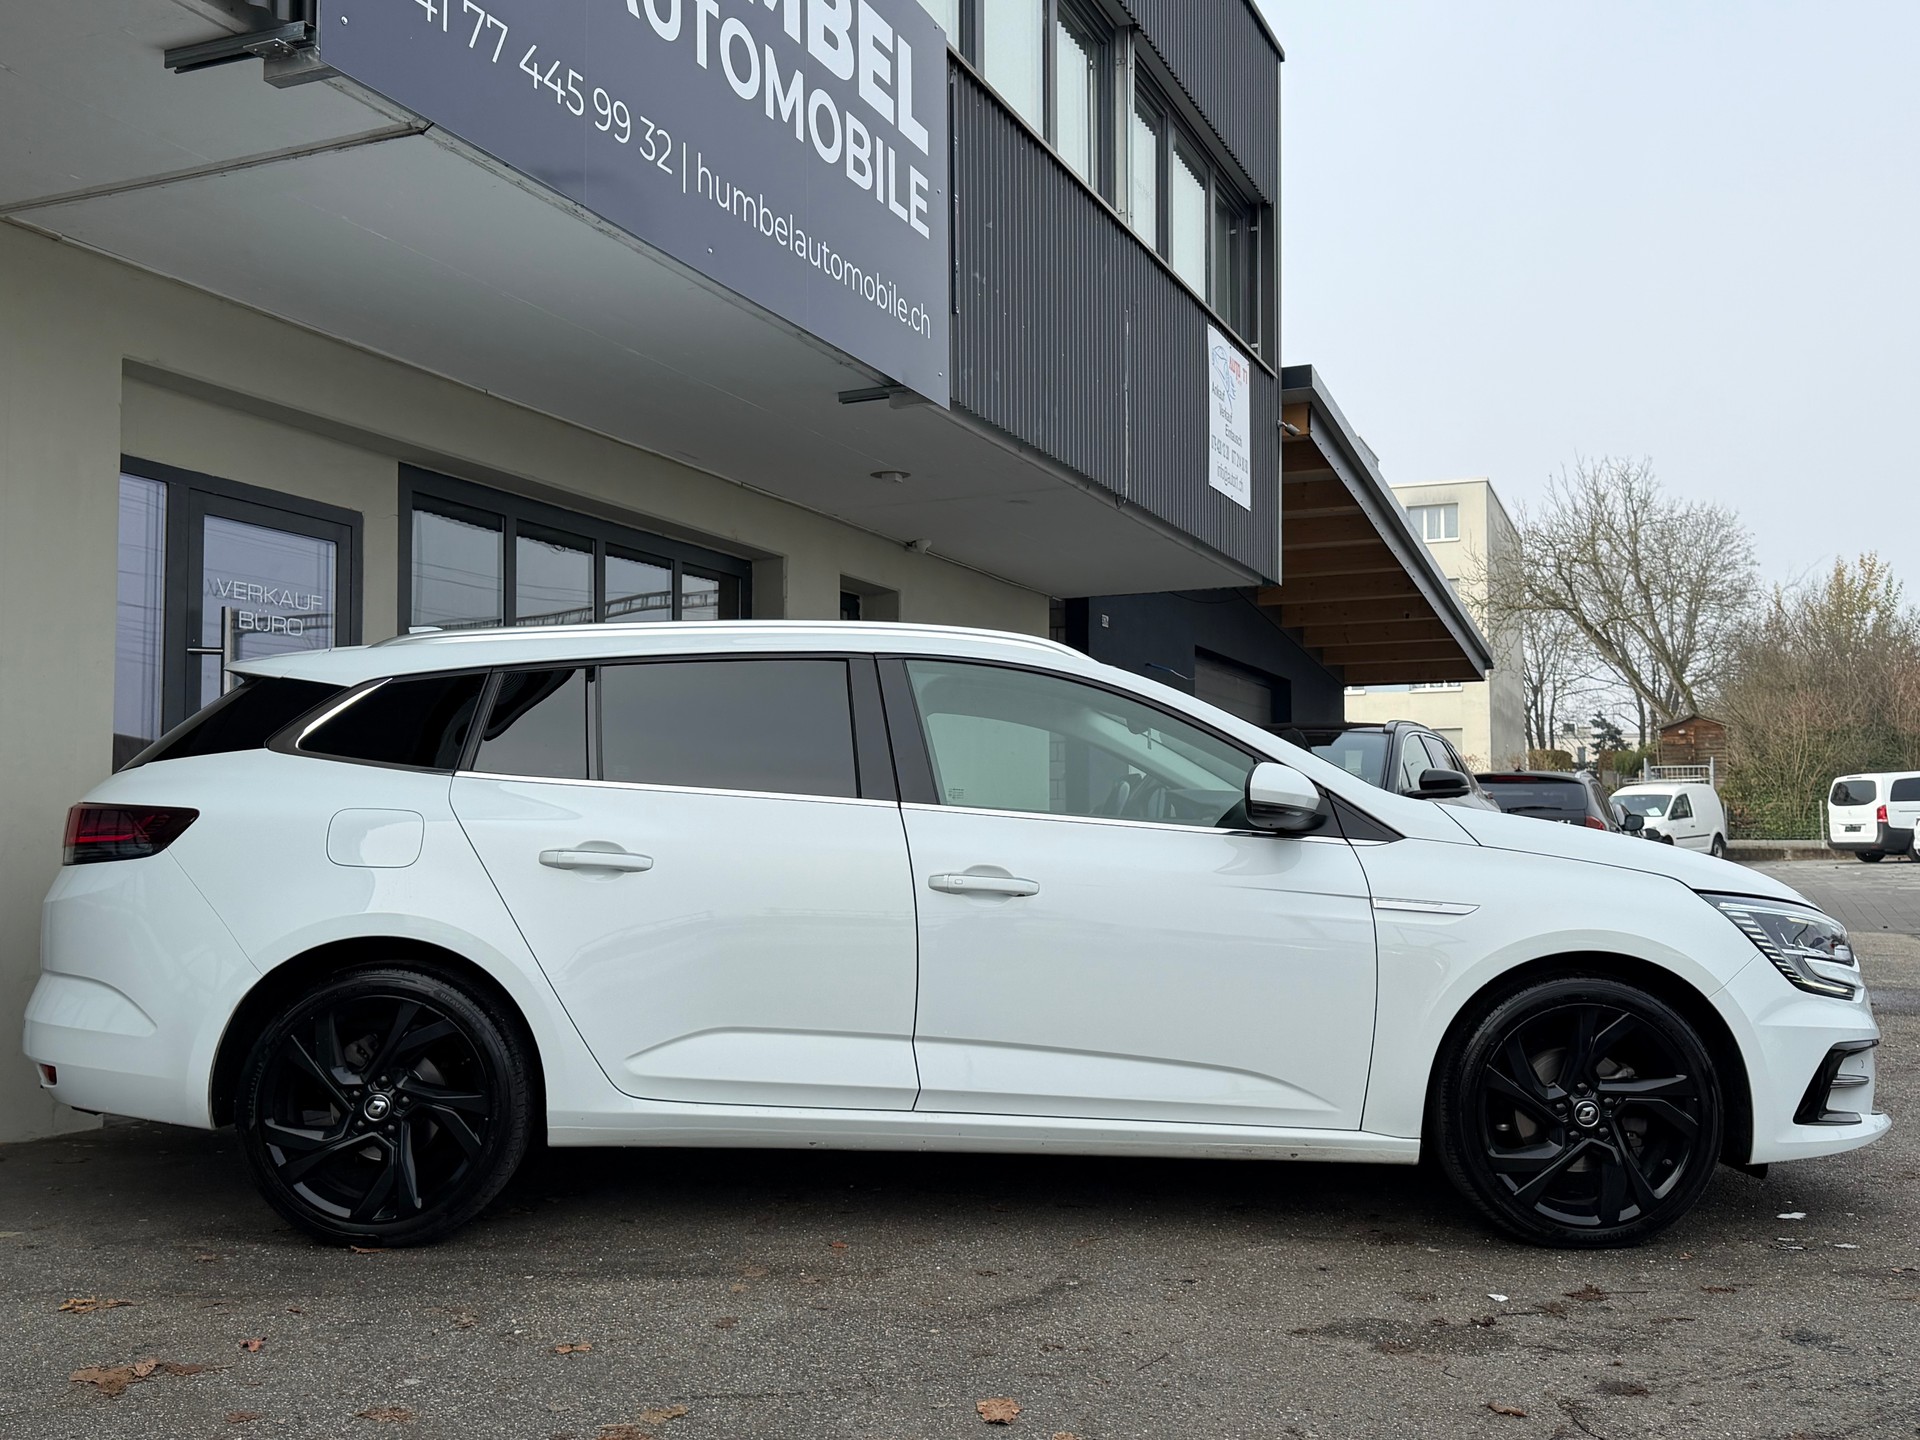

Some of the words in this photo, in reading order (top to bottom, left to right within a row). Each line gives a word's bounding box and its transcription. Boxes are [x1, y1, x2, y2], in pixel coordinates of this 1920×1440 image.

[463, 0, 509, 64] 77
[519, 44, 585, 117] 445
[593, 87, 631, 144] 99
[640, 115, 673, 175] 32
[697, 152, 931, 339] humbelautomobile.ch
[626, 0, 930, 240] UTOMOBILE
[216, 577, 323, 611] VERKAUF
[238, 608, 304, 637] BÜRO
